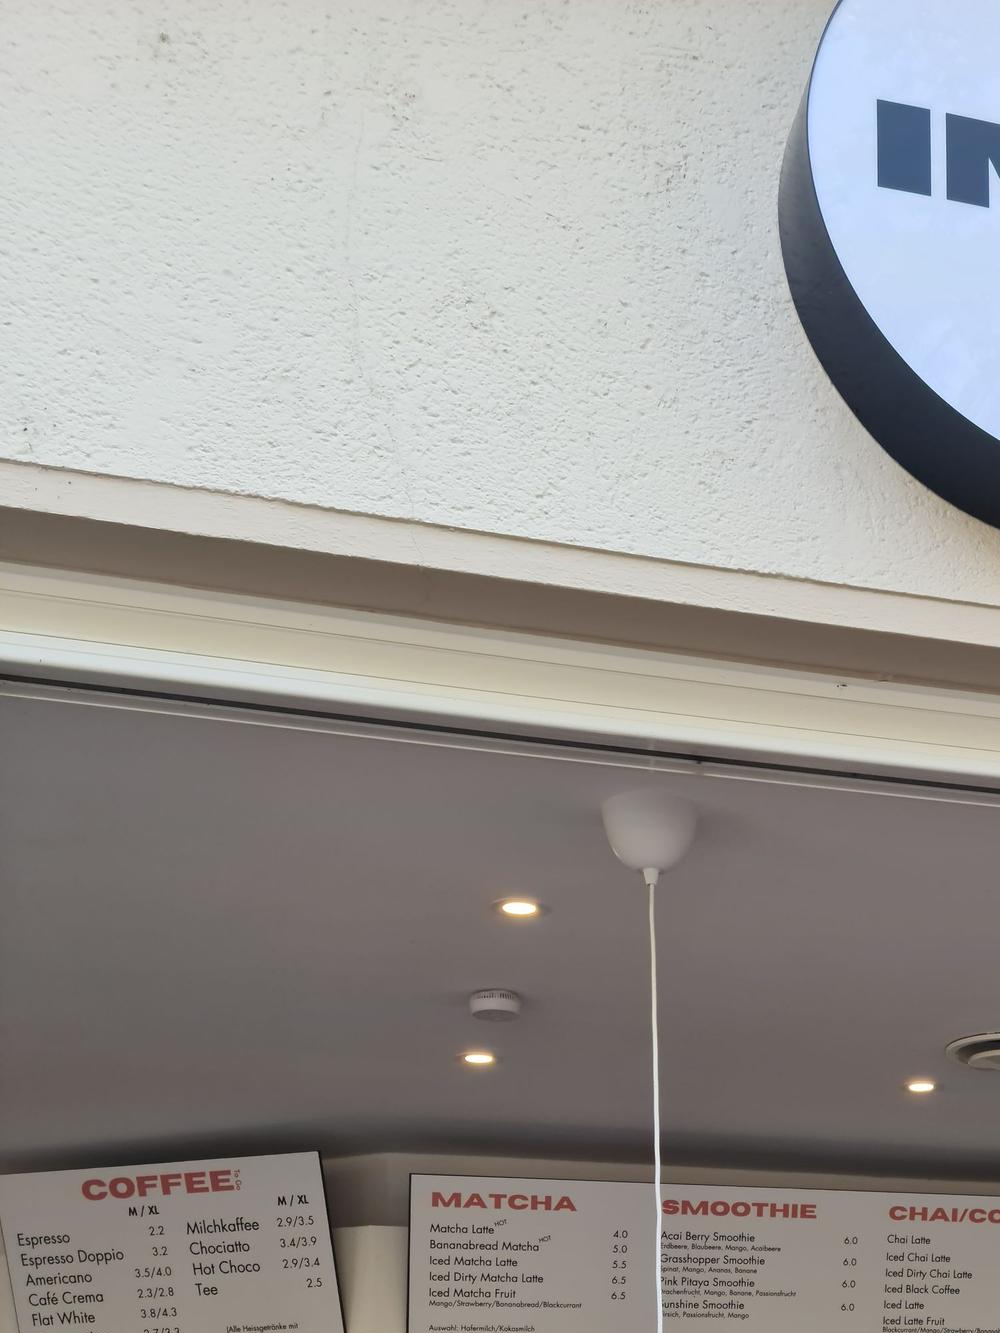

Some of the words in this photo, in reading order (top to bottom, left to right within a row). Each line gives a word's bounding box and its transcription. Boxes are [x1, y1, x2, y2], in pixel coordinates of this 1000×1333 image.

[82, 1170, 234, 1200] COFFEE
[278, 1196, 286, 1205] M
[297, 1195, 309, 1204] XL
[432, 1192, 577, 1211] MATCHA
[129, 1207, 137, 1217] M
[148, 1205, 159, 1215] XL
[662, 1200, 817, 1219] SMOOTHIE
[186, 1217, 259, 1235] Milchkaffee
[277, 1215, 314, 1227] 2.9/3.5
[149, 1226, 164, 1236] 2.2
[430, 1224, 468, 1234] Matcha
[472, 1225, 494, 1234] Latte
[17, 1232, 70, 1248] Espresso
[280, 1236, 317, 1248] 3.4/3.9
[686, 1232, 710, 1244] Berry
[713, 1233, 755, 1242] Smoothie
[844, 1237, 858, 1245] 6.0
[887, 1235, 908, 1244] Chai
[912, 1235, 931, 1245] Latte
[152, 1246, 168, 1256] 3.2
[189, 1241, 250, 1255] Chociatto
[430, 1240, 498, 1250] Bananabread
[502, 1242, 539, 1252] Matcha
[613, 1245, 627, 1253] 5.0
[21, 1253, 74, 1269] Espresso
[78, 1249, 124, 1266] Doppio
[282, 1258, 320, 1269] 2.9/3.4
[430, 1256, 450, 1265] Iced
[454, 1257, 492, 1266] Matcha
[496, 1257, 518, 1267] Latte
[660, 1254, 720, 1267] Grasshopper
[723, 1255, 765, 1265] Smoothie
[843, 1258, 857, 1266] 6.0
[887, 1253, 904, 1262] Iced
[908, 1253, 928, 1262] Chai
[931, 1254, 950, 1263] Latte
[134, 1266, 172, 1279] 3.5/4.0
[193, 1263, 215, 1276] Hot
[219, 1261, 260, 1274] Choco
[886, 1269, 903, 1278] Iced
[907, 1269, 926, 1280] Dirty
[930, 1270, 950, 1278] Chai
[953, 1270, 972, 1279] Latte
[26, 1272, 92, 1287] Americano
[306, 1278, 322, 1287] 2.5
[430, 1272, 450, 1282] Iced
[454, 1273, 477, 1284] Dirty
[481, 1273, 518, 1283] Matcha
[522, 1274, 543, 1283] Latte
[612, 1276, 626, 1284] 6.5
[681, 1277, 709, 1289] Pitaya
[713, 1278, 754, 1288] Smoothie
[842, 1280, 856, 1288] 6.0
[137, 1287, 174, 1300] 2.3/2.8
[195, 1284, 218, 1296] Tee
[429, 1288, 449, 1298] Iced
[453, 1289, 491, 1298] Matcha
[495, 1289, 516, 1298] Fruit
[885, 1284, 902, 1294] Iced
[906, 1285, 928, 1294] Black
[931, 1285, 960, 1295] Coffee
[29, 1291, 58, 1307] Café
[62, 1291, 103, 1305] Crema
[611, 1292, 626, 1300] 6.5
[702, 1300, 744, 1310] Smoothie
[884, 1301, 901, 1309] Iced
[905, 1301, 924, 1310] Latte
[32, 1314, 53, 1327] Flat
[57, 1312, 96, 1325] White
[140, 1307, 177, 1320] 3.8/4.3
[883, 1316, 900, 1325] Iced
[904, 1317, 923, 1325] Latte
[927, 1317, 945, 1325] Fruit
